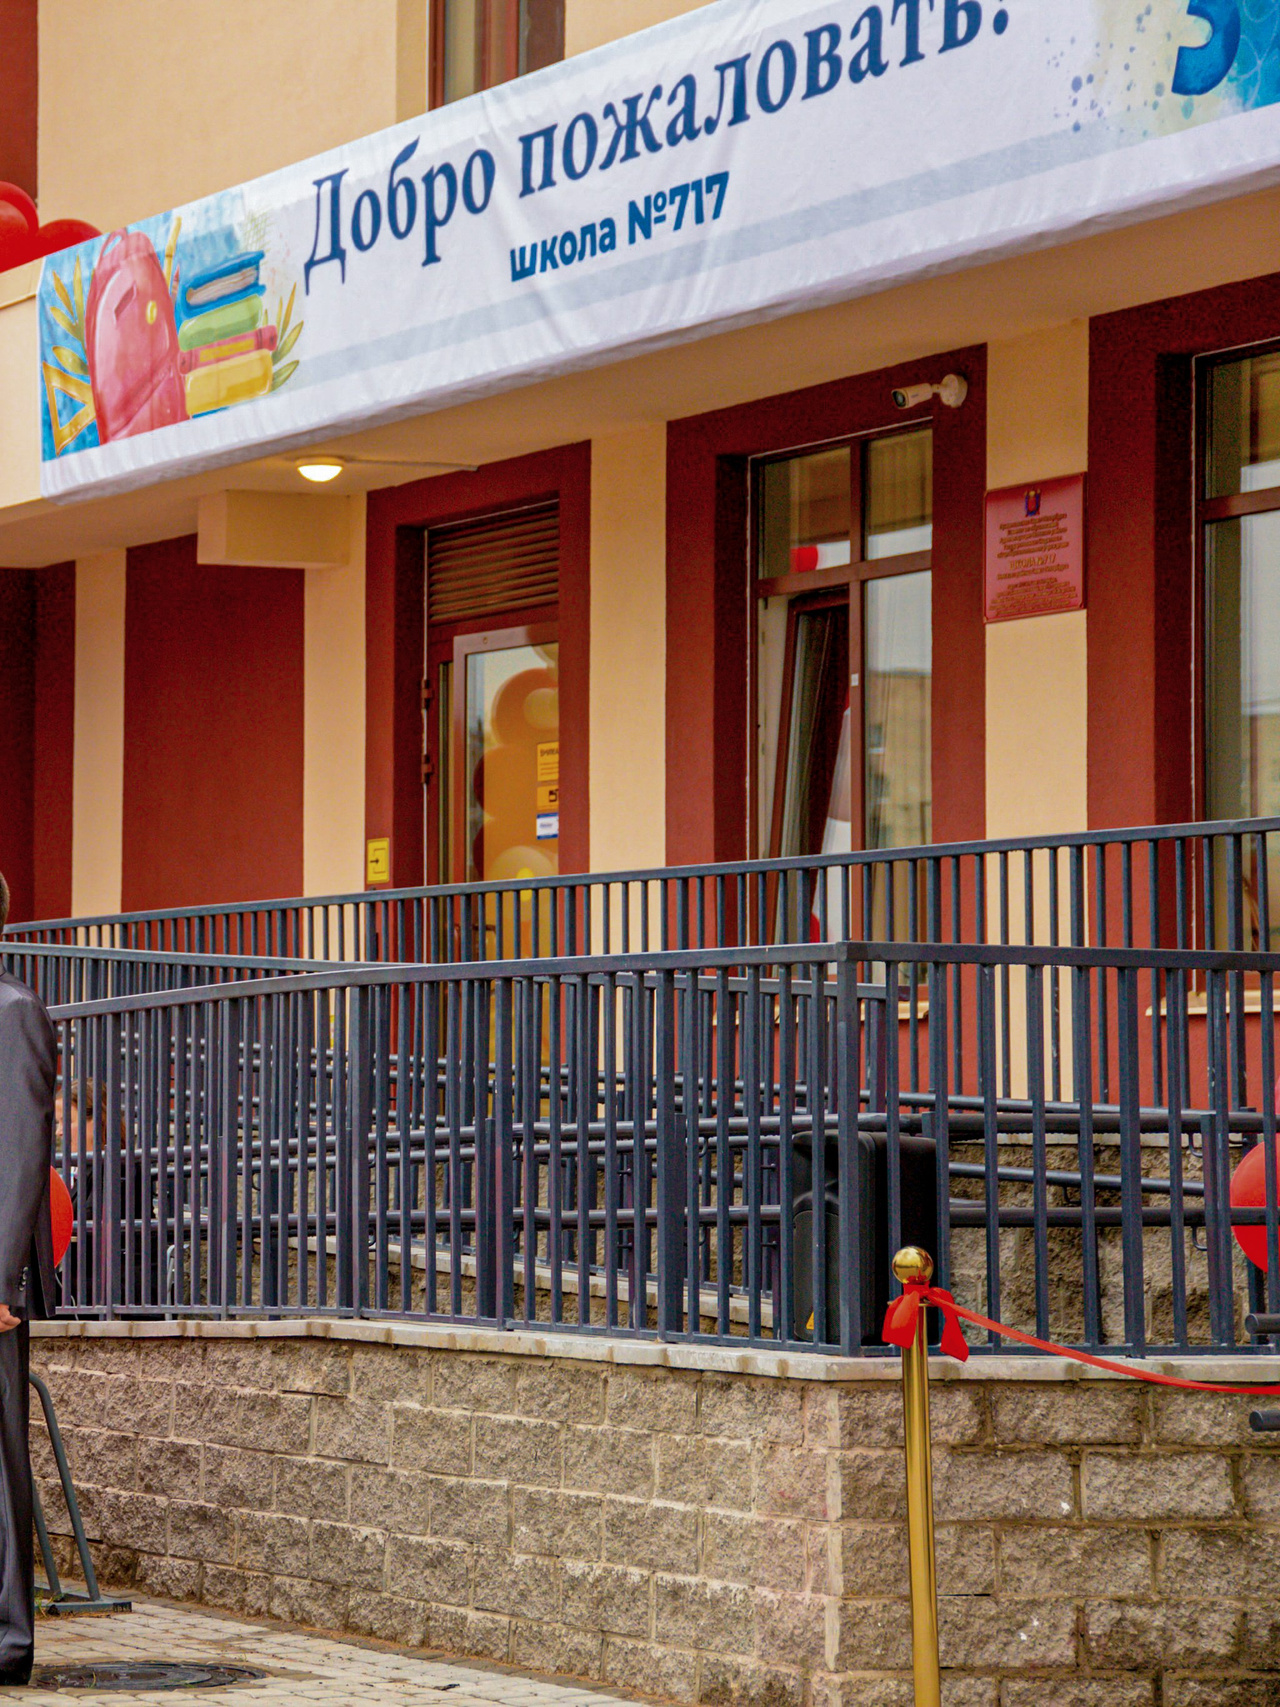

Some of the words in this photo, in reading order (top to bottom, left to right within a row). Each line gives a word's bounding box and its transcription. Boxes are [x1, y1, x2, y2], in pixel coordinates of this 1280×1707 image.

[304, 135, 496, 296] Добро
[518, 0, 1010, 199] пожаловать
[510, 217, 617, 282] школа
[628, 171, 730, 245] №717
